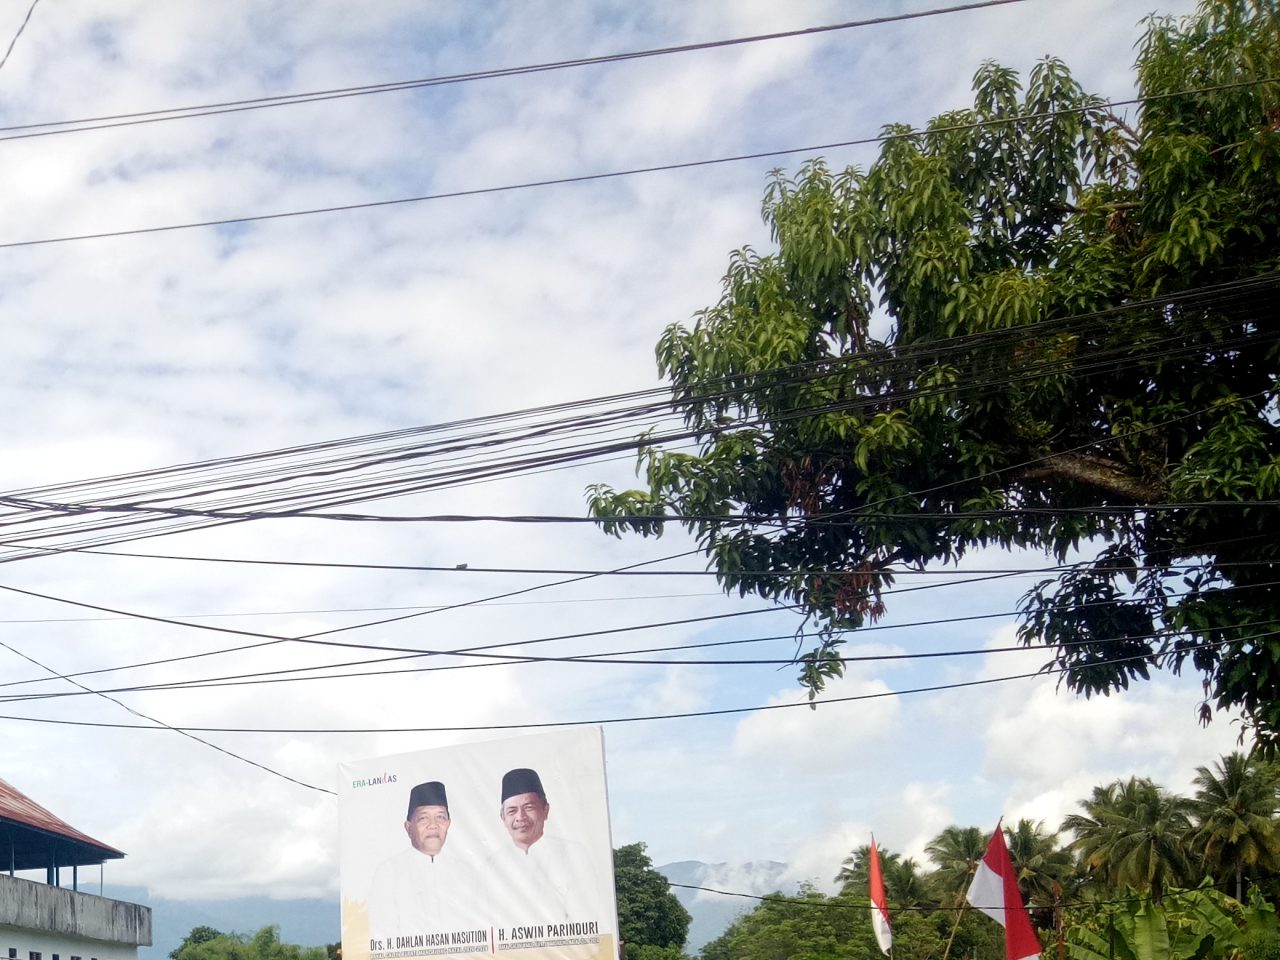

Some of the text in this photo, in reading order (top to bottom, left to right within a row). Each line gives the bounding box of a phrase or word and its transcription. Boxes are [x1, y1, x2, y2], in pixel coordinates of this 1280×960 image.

[370, 938, 385, 951] Drs.
[387, 937, 394, 950] H.
[396, 934, 424, 949] DAHLAN
[426, 932, 450, 946] HASAN
[451, 930, 487, 945] NASUTION
[499, 921, 598, 941] H. ASWIN PARINDURI
